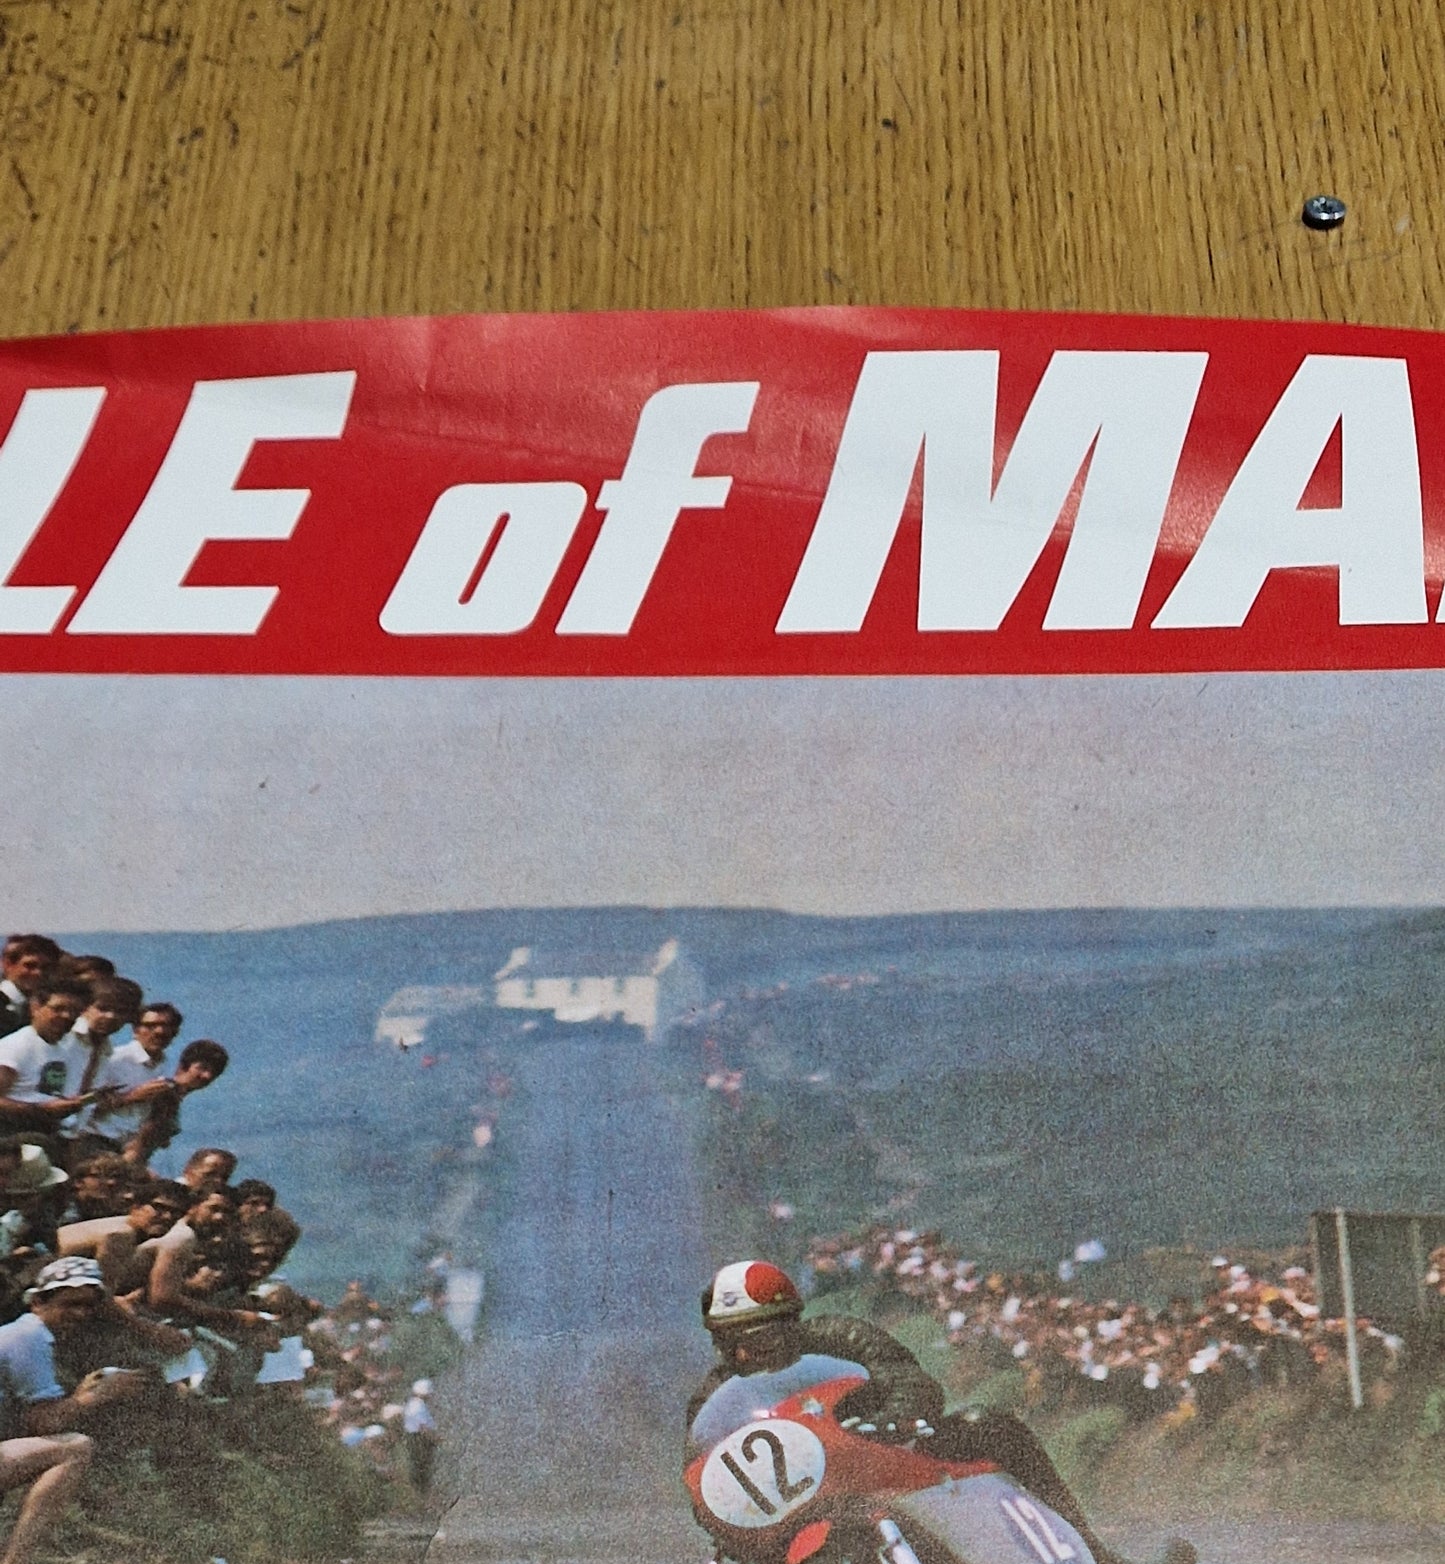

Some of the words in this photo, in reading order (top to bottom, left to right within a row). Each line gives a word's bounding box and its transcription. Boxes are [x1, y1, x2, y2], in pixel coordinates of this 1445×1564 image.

[379, 381, 760, 635] of
[775, 350, 1445, 633] MA
[721, 1430, 815, 1516] 12
[1001, 1497, 1076, 1564] 12
